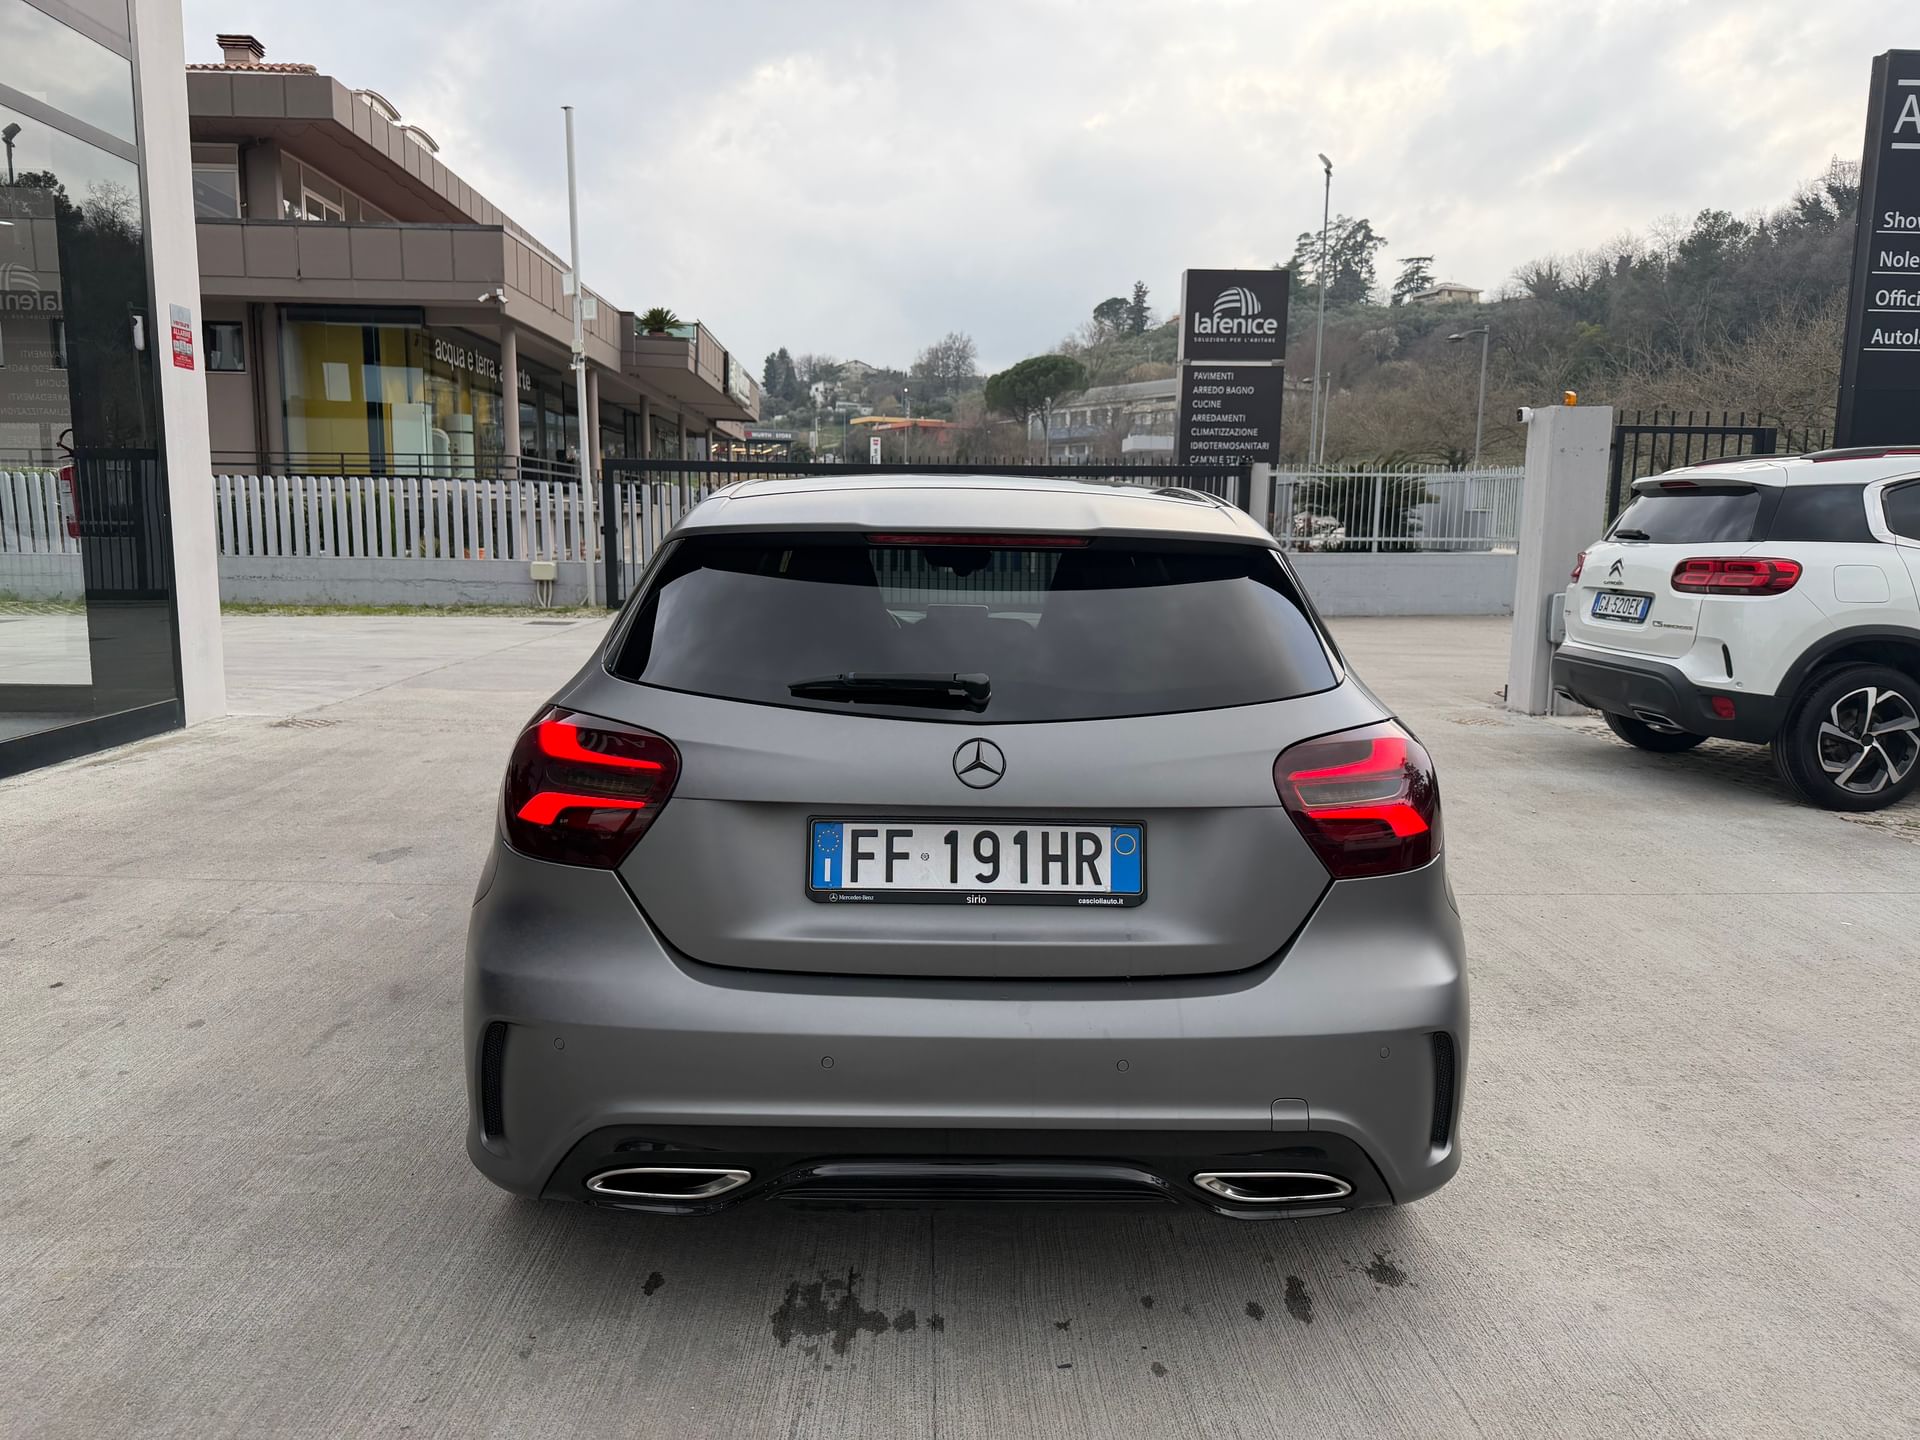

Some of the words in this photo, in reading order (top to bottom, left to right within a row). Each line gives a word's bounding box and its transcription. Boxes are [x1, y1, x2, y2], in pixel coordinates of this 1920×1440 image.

[1883, 211, 1920, 229] Sho
[1194, 312, 1278, 334] lafenice
[1871, 328, 1920, 345] Autol
[435, 339, 465, 371] acqua
[467, 351, 474, 371] e
[1193, 372, 1234, 380] PAVIMENTI
[1193, 386, 1224, 394] ARREDO
[1226, 386, 1254, 394] BAGNO
[1192, 400, 1222, 408] CUCINE
[1191, 414, 1246, 422] ARREDAMENTI
[1191, 428, 1258, 436] CLIMATIZZAZIONE
[1190, 442, 1270, 450] IDROTERMOSANITARI
[850, 829, 913, 883] FF
[944, 830, 1103, 885] 191HR
[966, 894, 987, 904] sirio
